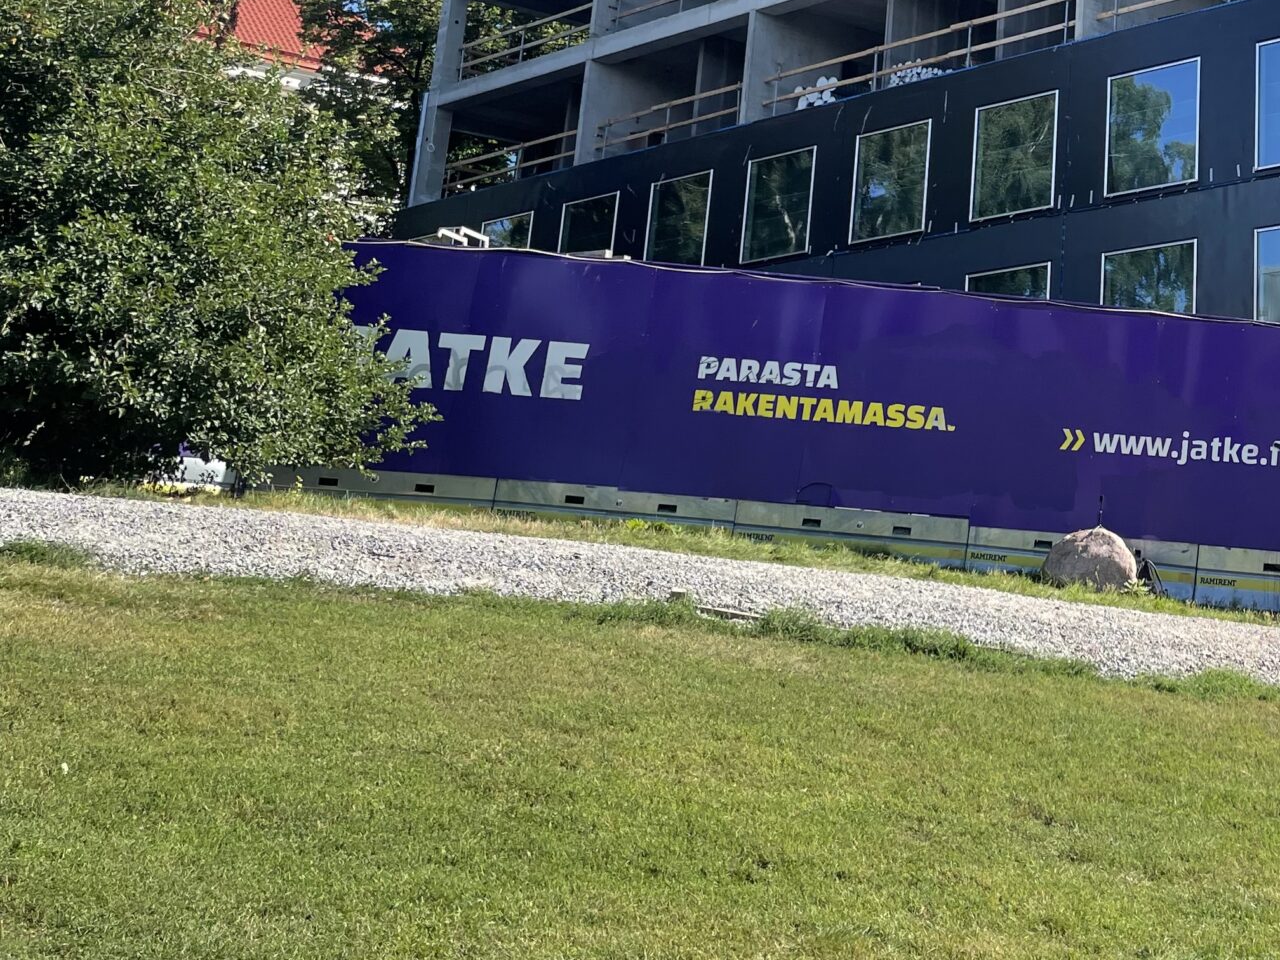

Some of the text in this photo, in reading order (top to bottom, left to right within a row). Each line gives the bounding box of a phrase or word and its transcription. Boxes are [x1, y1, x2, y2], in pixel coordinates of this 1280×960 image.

[697, 356, 839, 389] PARASTA
[692, 389, 956, 432] RAKENTAMASSA.
[970, 551, 1008, 562] RAMIRENT
[1199, 576, 1238, 587] RAMIRENT
